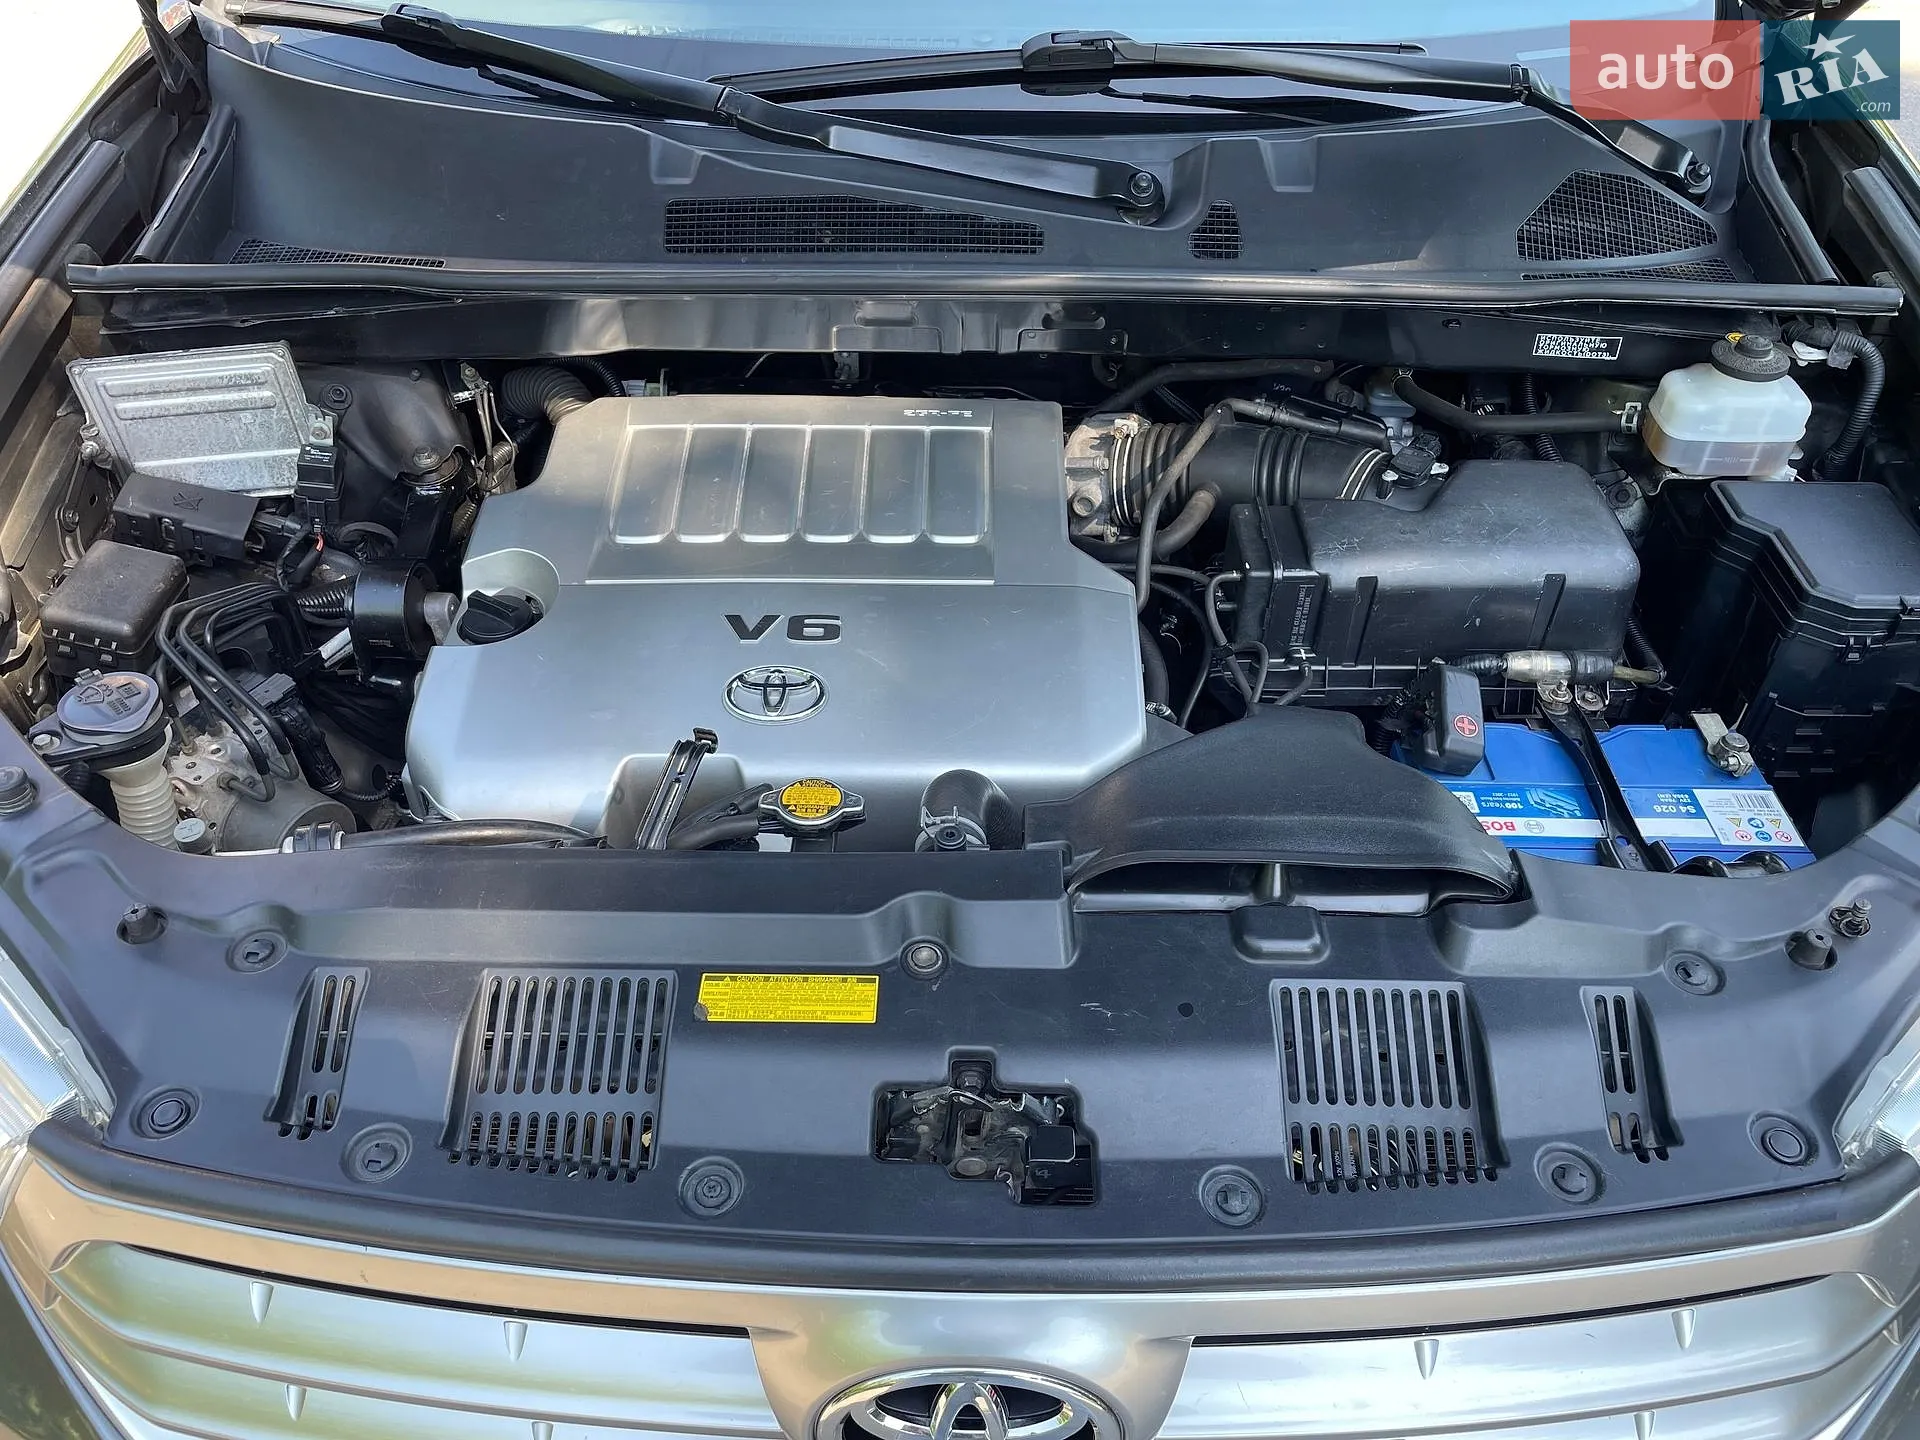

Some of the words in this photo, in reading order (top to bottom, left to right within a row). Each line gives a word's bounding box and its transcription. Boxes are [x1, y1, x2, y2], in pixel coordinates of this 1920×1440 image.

[723, 613, 843, 644] V6
[1481, 801, 1504, 809] Years
[1505, 802, 1524, 810] 100
[1653, 804, 1677, 814] 026
[1679, 804, 1697, 814] S4
[769, 975, 803, 983] ATTENTION
